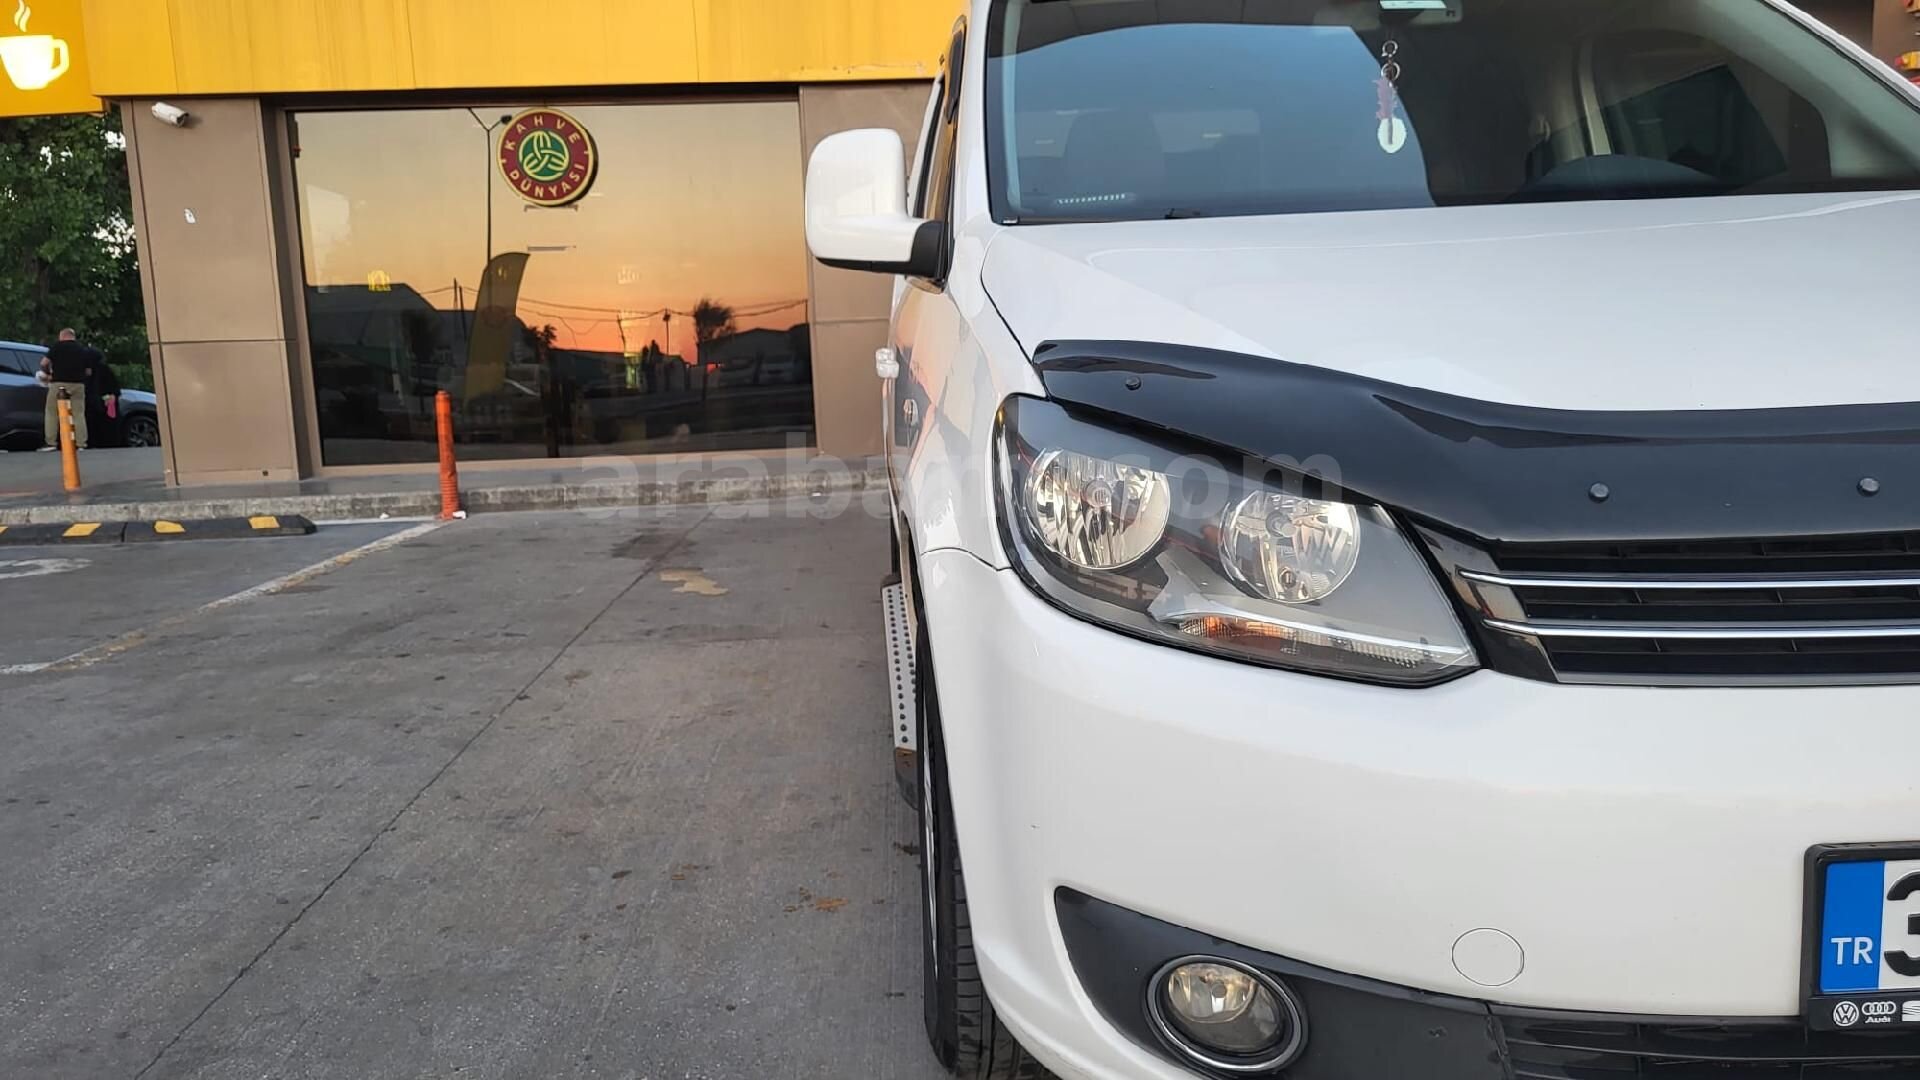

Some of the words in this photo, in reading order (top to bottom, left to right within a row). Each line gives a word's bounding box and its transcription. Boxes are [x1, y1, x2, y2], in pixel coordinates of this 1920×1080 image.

[505, 115, 580, 151] KAHVE
[1831, 936, 1873, 965] TR
[1864, 1015, 1891, 1024] Audi
